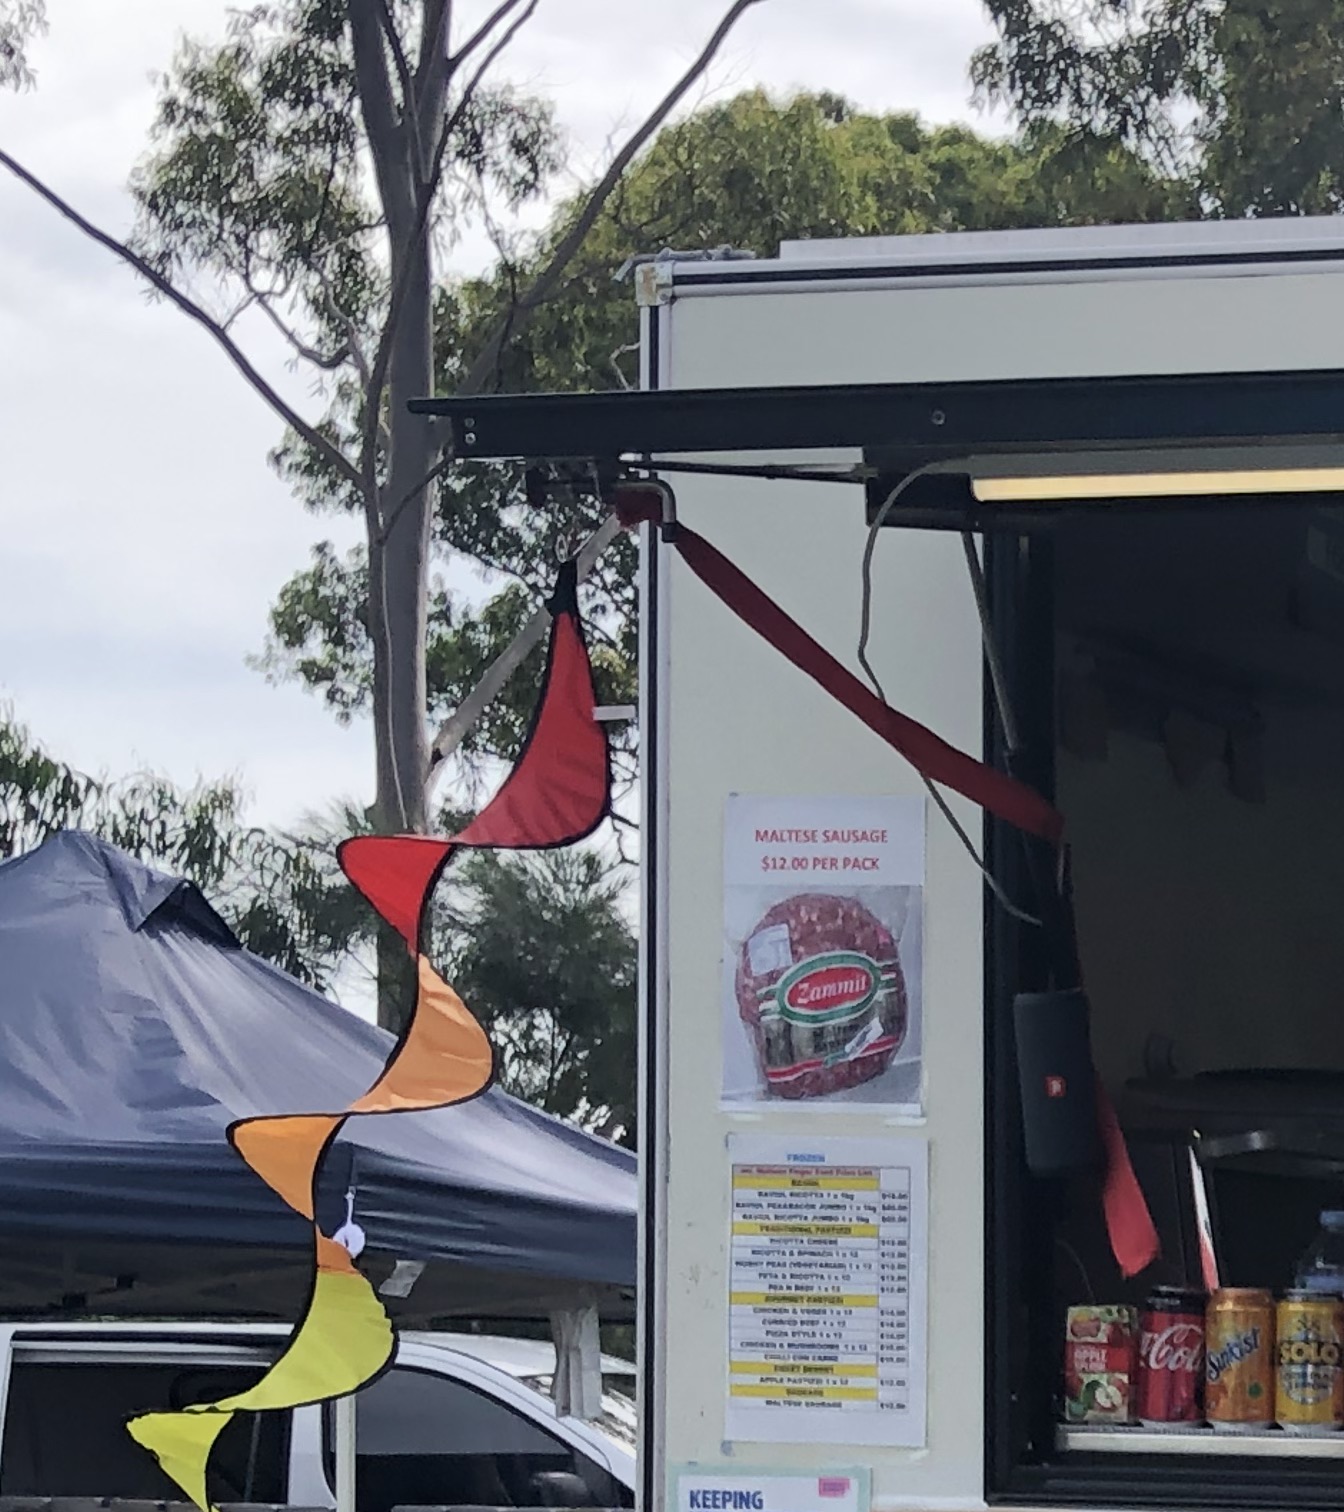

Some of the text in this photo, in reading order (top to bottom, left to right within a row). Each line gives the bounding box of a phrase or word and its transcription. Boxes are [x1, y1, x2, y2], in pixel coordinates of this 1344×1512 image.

[755, 829, 889, 844] MALTESE SAUSAGE
[761, 856, 880, 871] $12.00 PER PACK
[1207, 1327, 1261, 1383] Sunkist
[1280, 1341, 1339, 1365] SOLO
[689, 1489, 764, 1510] KEEPING
